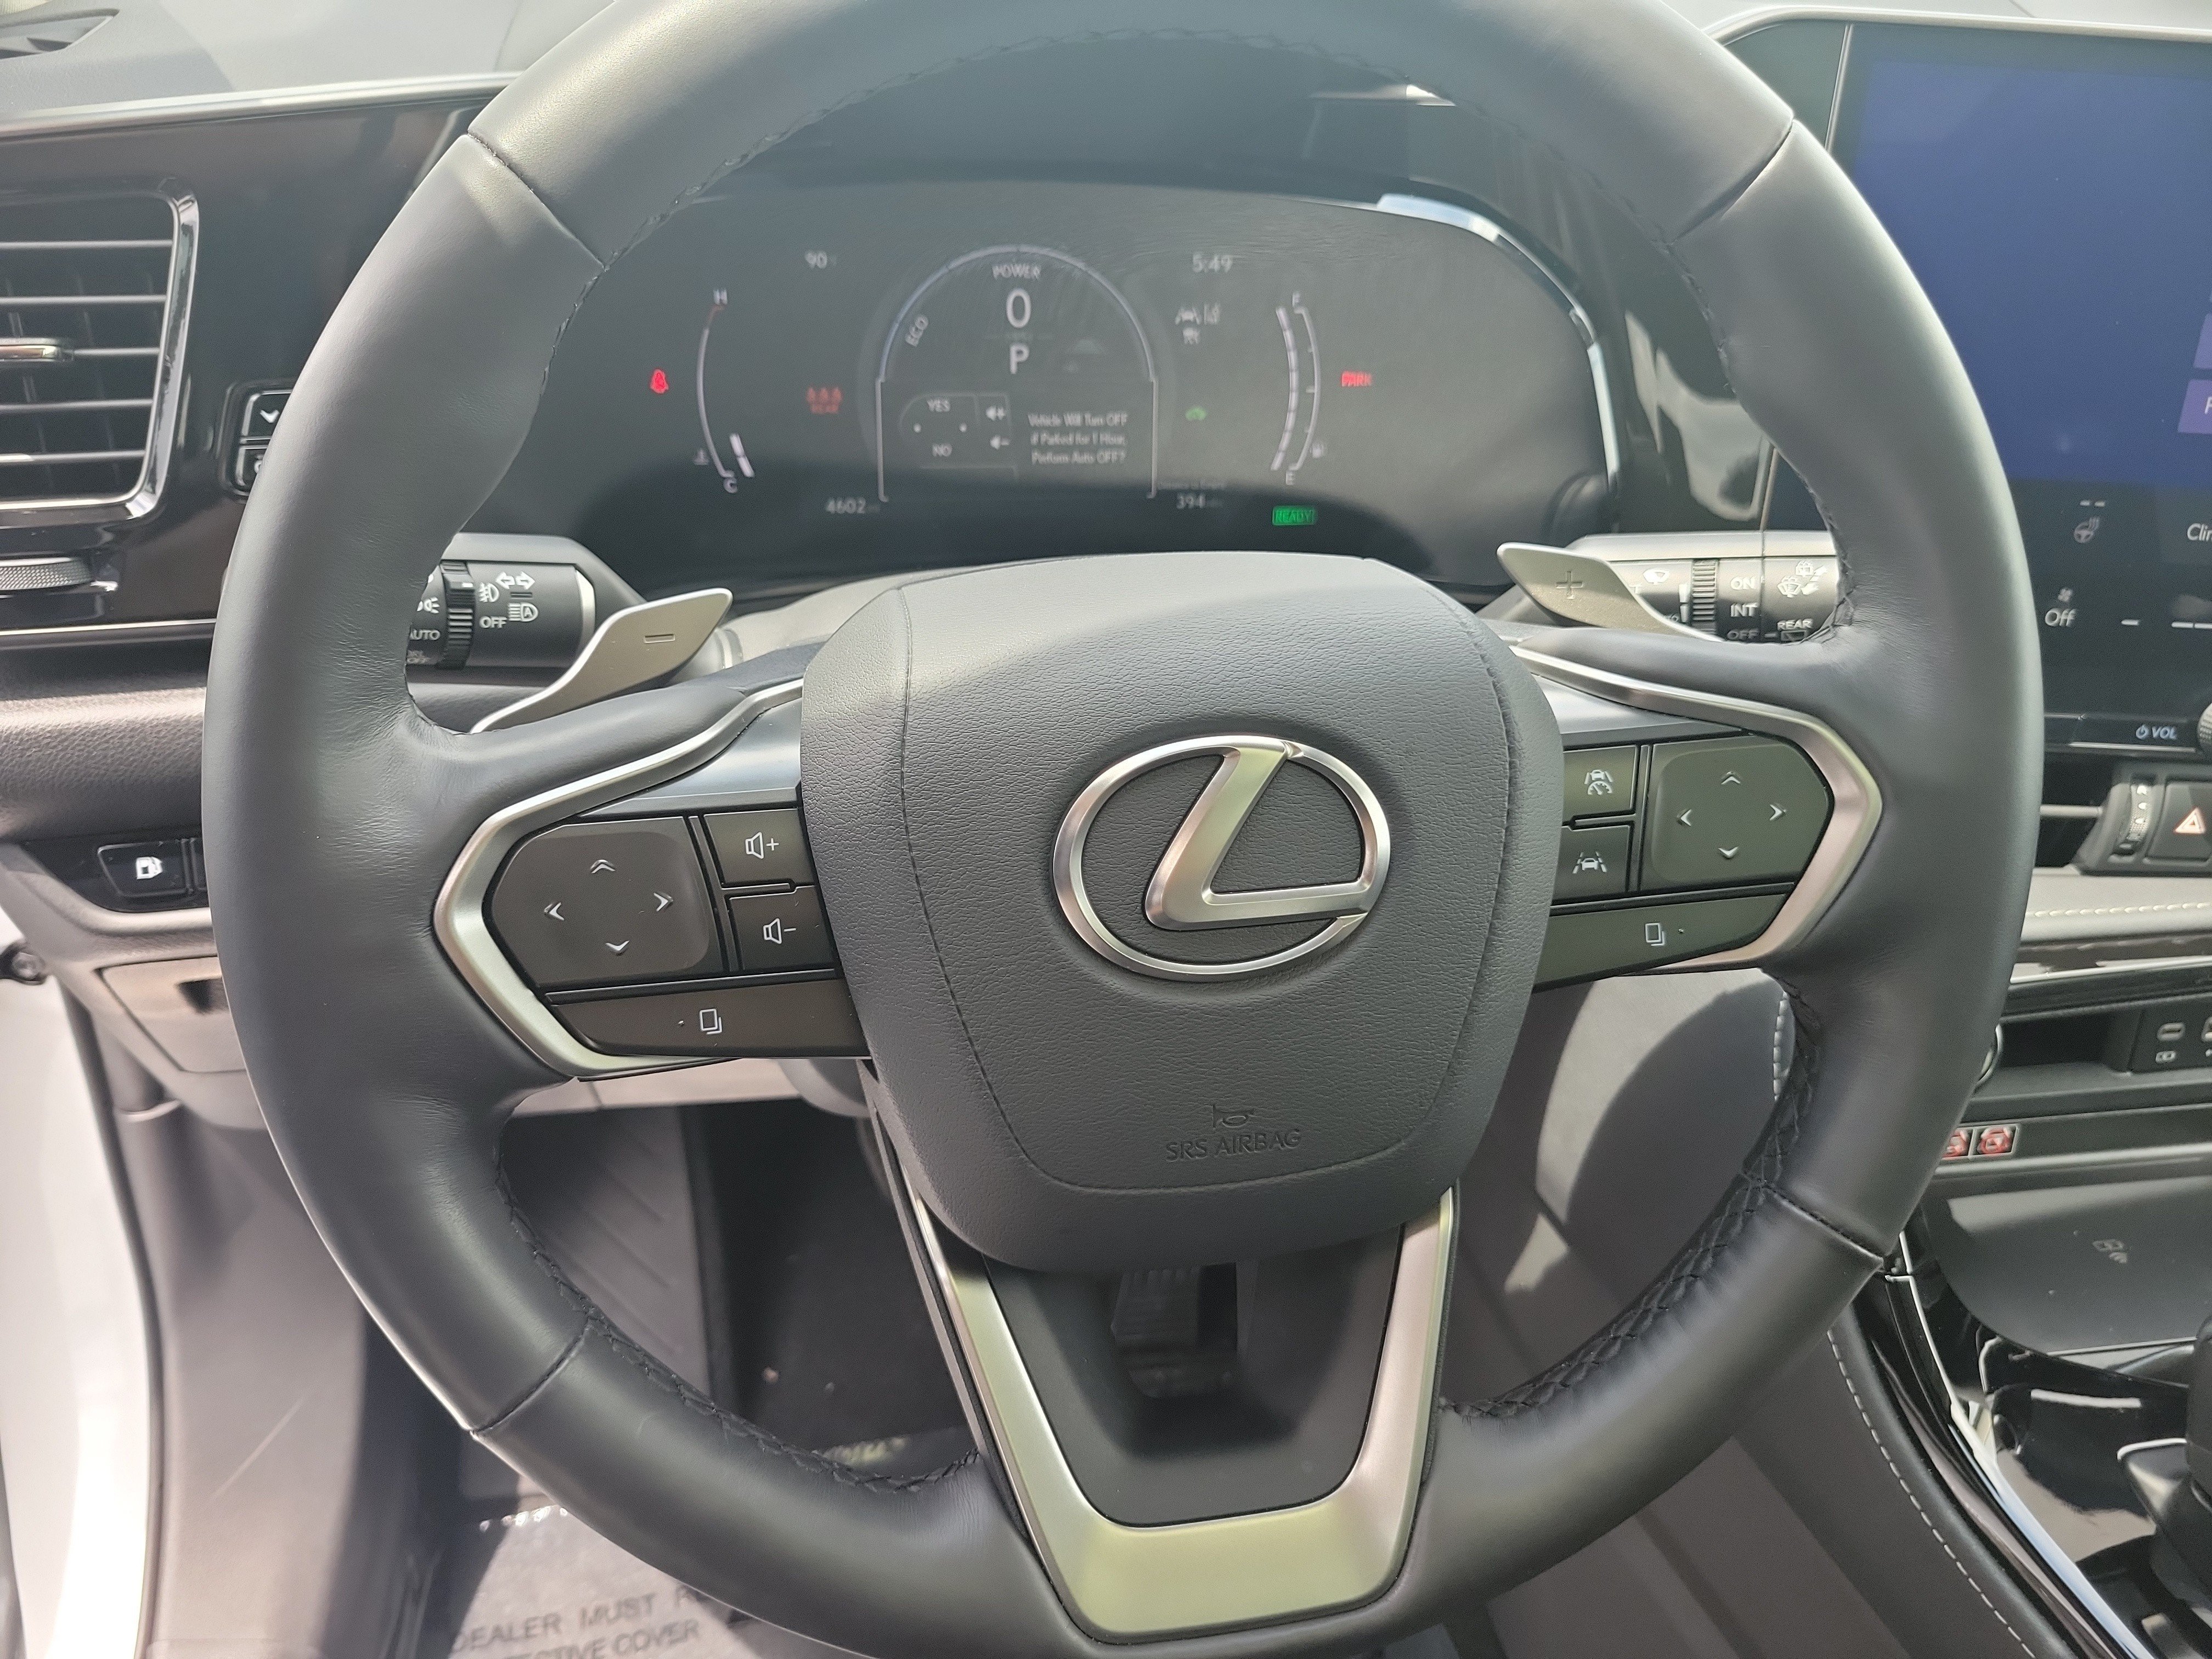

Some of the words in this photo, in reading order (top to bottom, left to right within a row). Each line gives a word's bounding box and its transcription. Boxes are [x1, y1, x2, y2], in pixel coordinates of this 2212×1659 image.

[1193, 254, 1233, 273] 5:49
[992, 264, 1041, 279] POWER
[905, 315, 928, 347] ECO
[1010, 343, 1030, 375] P
[933, 443, 953, 457] NO
[1730, 576, 1757, 590] ON
[1730, 602, 1759, 617] INT
[479, 616, 507, 629] OFF
[1777, 618, 1813, 631] REAR
[2045, 608, 2078, 627] Off
[1726, 628, 1759, 641] OFF
[2152, 725, 2177, 740] VOL
[1165, 1138, 1209, 1162] SRS
[1214, 1127, 1302, 1156] AIRBAG
[579, 1592, 657, 1628] MUST
[612, 1618, 701, 1656] COVER
